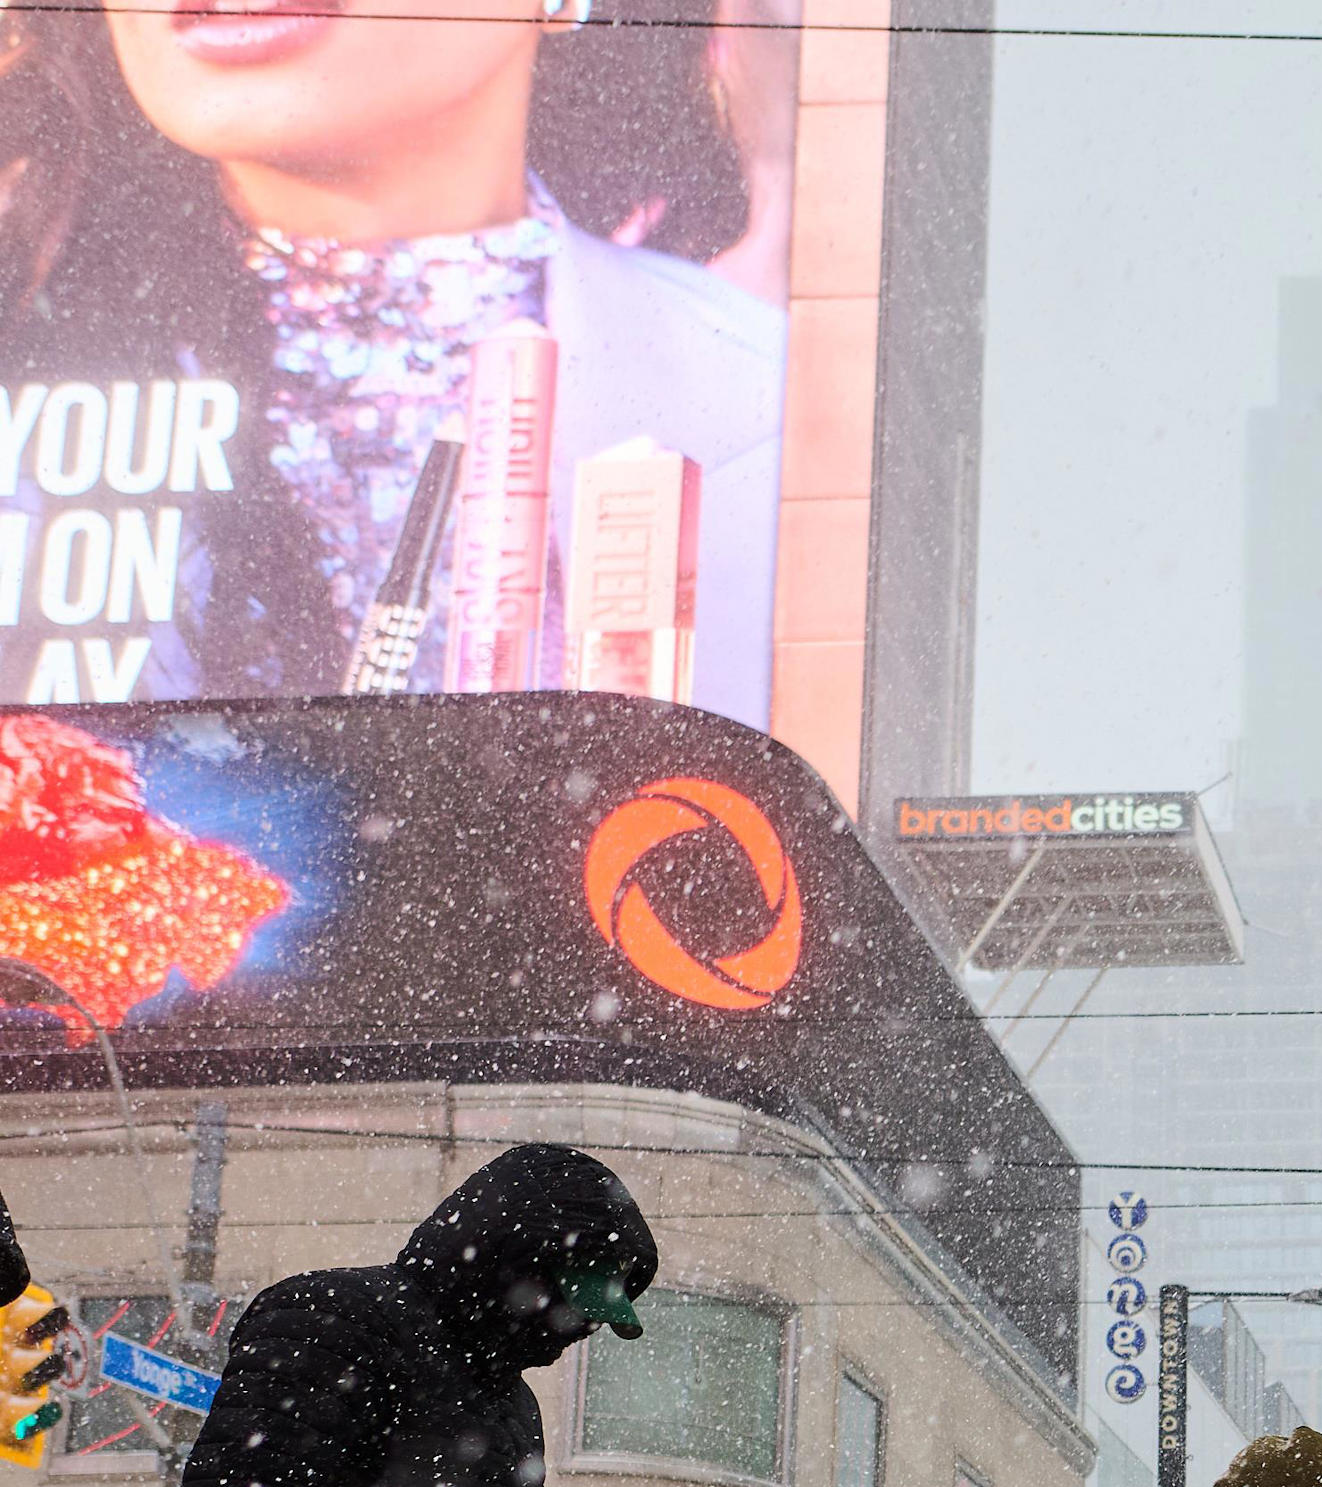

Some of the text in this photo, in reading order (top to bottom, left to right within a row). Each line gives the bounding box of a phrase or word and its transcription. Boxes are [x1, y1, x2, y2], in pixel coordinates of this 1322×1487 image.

[0, 379, 240, 496] YOUR
[40, 506, 183, 626] ON
[899, 798, 1184, 835] brandedcities
[1104, 1190, 1149, 1405] Yonge
[131, 1349, 182, 1398] Yonge
[1161, 1301, 1179, 1451] DOWNTOWN
